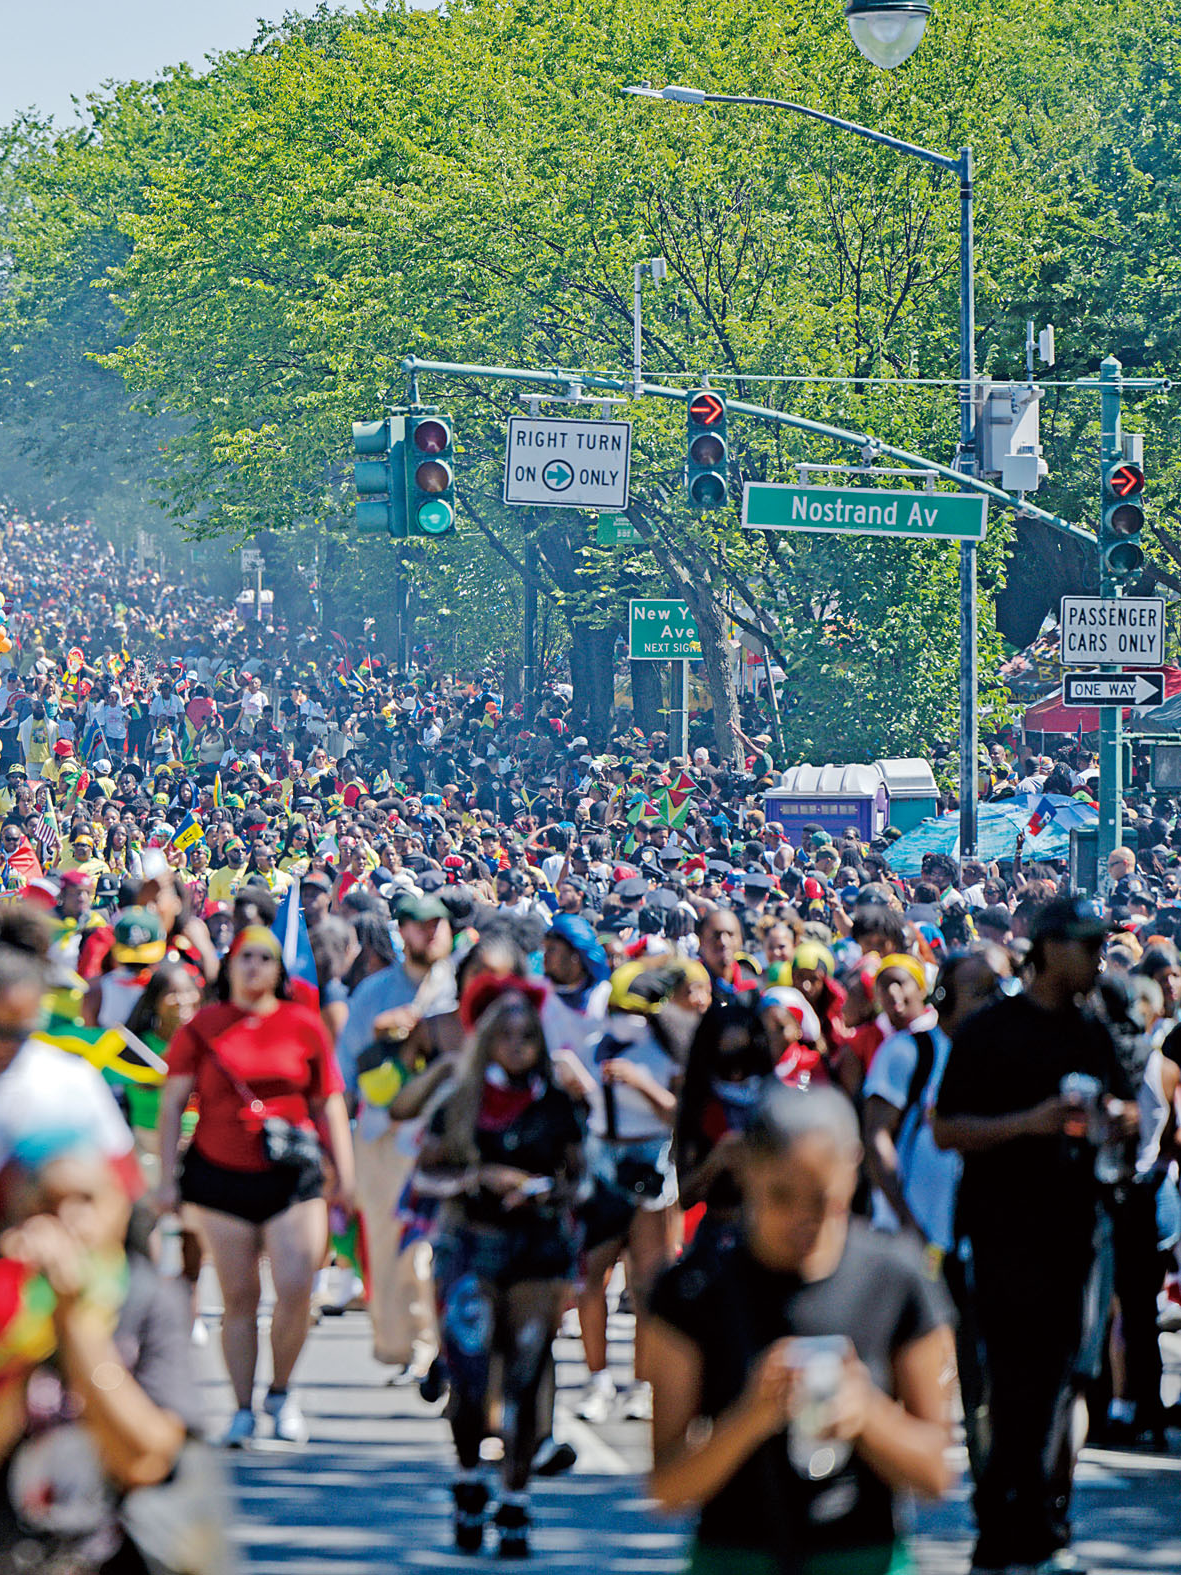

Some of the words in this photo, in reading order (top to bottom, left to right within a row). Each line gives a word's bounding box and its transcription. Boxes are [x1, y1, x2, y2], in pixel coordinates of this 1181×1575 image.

[516, 430, 568, 448] RIGHT
[576, 433, 621, 451] TURN
[515, 465, 536, 482] ON
[579, 468, 619, 486] ONLY
[791, 495, 898, 526] Nostrand
[907, 501, 939, 527] Av
[634, 606, 670, 620] New
[1069, 607, 1157, 627] PASSENGER
[660, 624, 695, 638] Ave
[644, 643, 670, 653] NEXT
[1068, 632, 1107, 652] CARS
[1118, 633, 1156, 653] ONLY
[1074, 683, 1101, 696] ONE
[1109, 683, 1137, 696] WAY
